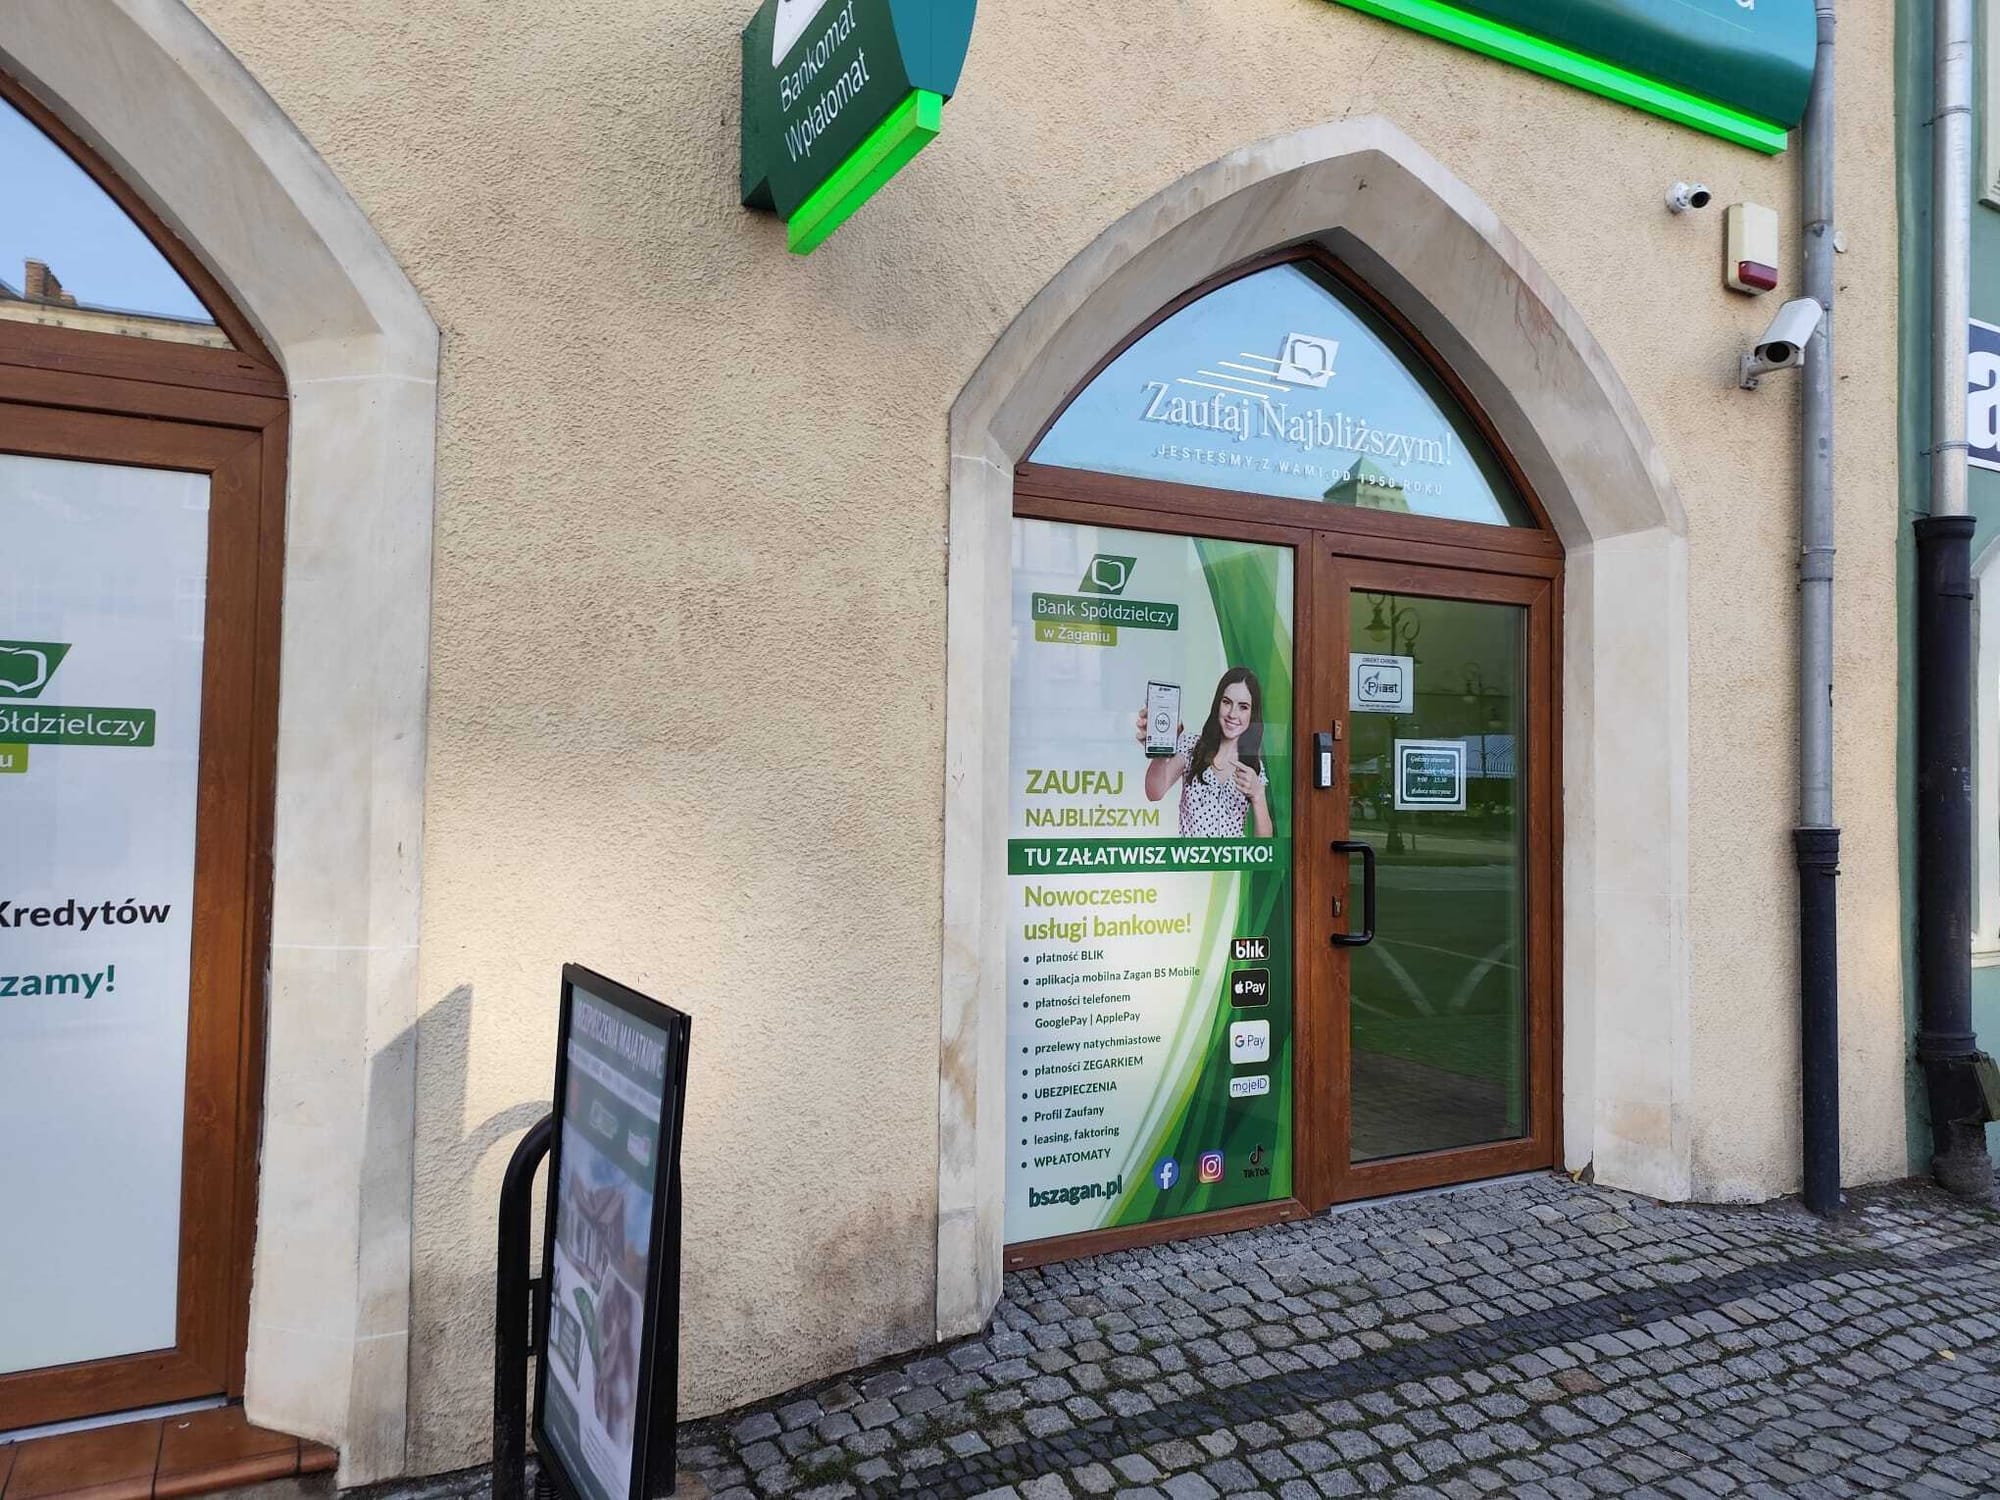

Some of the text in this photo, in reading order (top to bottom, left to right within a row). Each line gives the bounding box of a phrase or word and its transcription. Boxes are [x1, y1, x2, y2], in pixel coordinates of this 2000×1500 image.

[779, 1, 857, 112] Bankomat
[784, 47, 870, 163] Wpłatomat
[1142, 381, 1451, 467] Zaufaj Najbliższym!
[1158, 443, 1442, 495] JESTEŚMY Z WAMI OD 1950 ROKU
[1037, 597, 1174, 627] Bank Spółdzielczy
[1043, 624, 1111, 643] w Żaganiu
[1025, 769, 1124, 795] ZAUFAJ
[1025, 804, 1160, 827] NAJBLIŻSZYM
[1024, 845, 1273, 867] TU ZAŁATWISZ WSZYSTKO!
[1024, 885, 1158, 908] Nowoczesne
[1023, 912, 1191, 943] usługi bankowe!
[1035, 949, 1104, 965] płatność BLIK
[1235, 940, 1264, 958] blik
[0, 964, 115, 999] zamy!
[1035, 966, 1200, 987] aplikacja mobilna Zagan BS Mobile
[1245, 980, 1266, 996] Pay
[1035, 993, 1131, 1010] płatności telefonem
[1034, 1015, 1088, 1029] GooglePay
[1095, 1011, 1141, 1025] ApplePay
[1034, 1033, 1162, 1055] przelewy natychmiastowe
[1234, 1034, 1266, 1049] G Pay
[1034, 1055, 1144, 1078] płatności ZEGARKIEM
[1034, 1080, 1118, 1099] UBEZPIECZENIA
[1232, 1077, 1267, 1093] mojeID
[1034, 1105, 1105, 1122] Profil Zaufany
[1034, 1125, 1120, 1145] leasing, faktoring
[1033, 1147, 1112, 1168] WPŁATOMATY
[1243, 1167, 1270, 1179] TikTok
[1028, 1174, 1123, 1208] bszagan.pl
